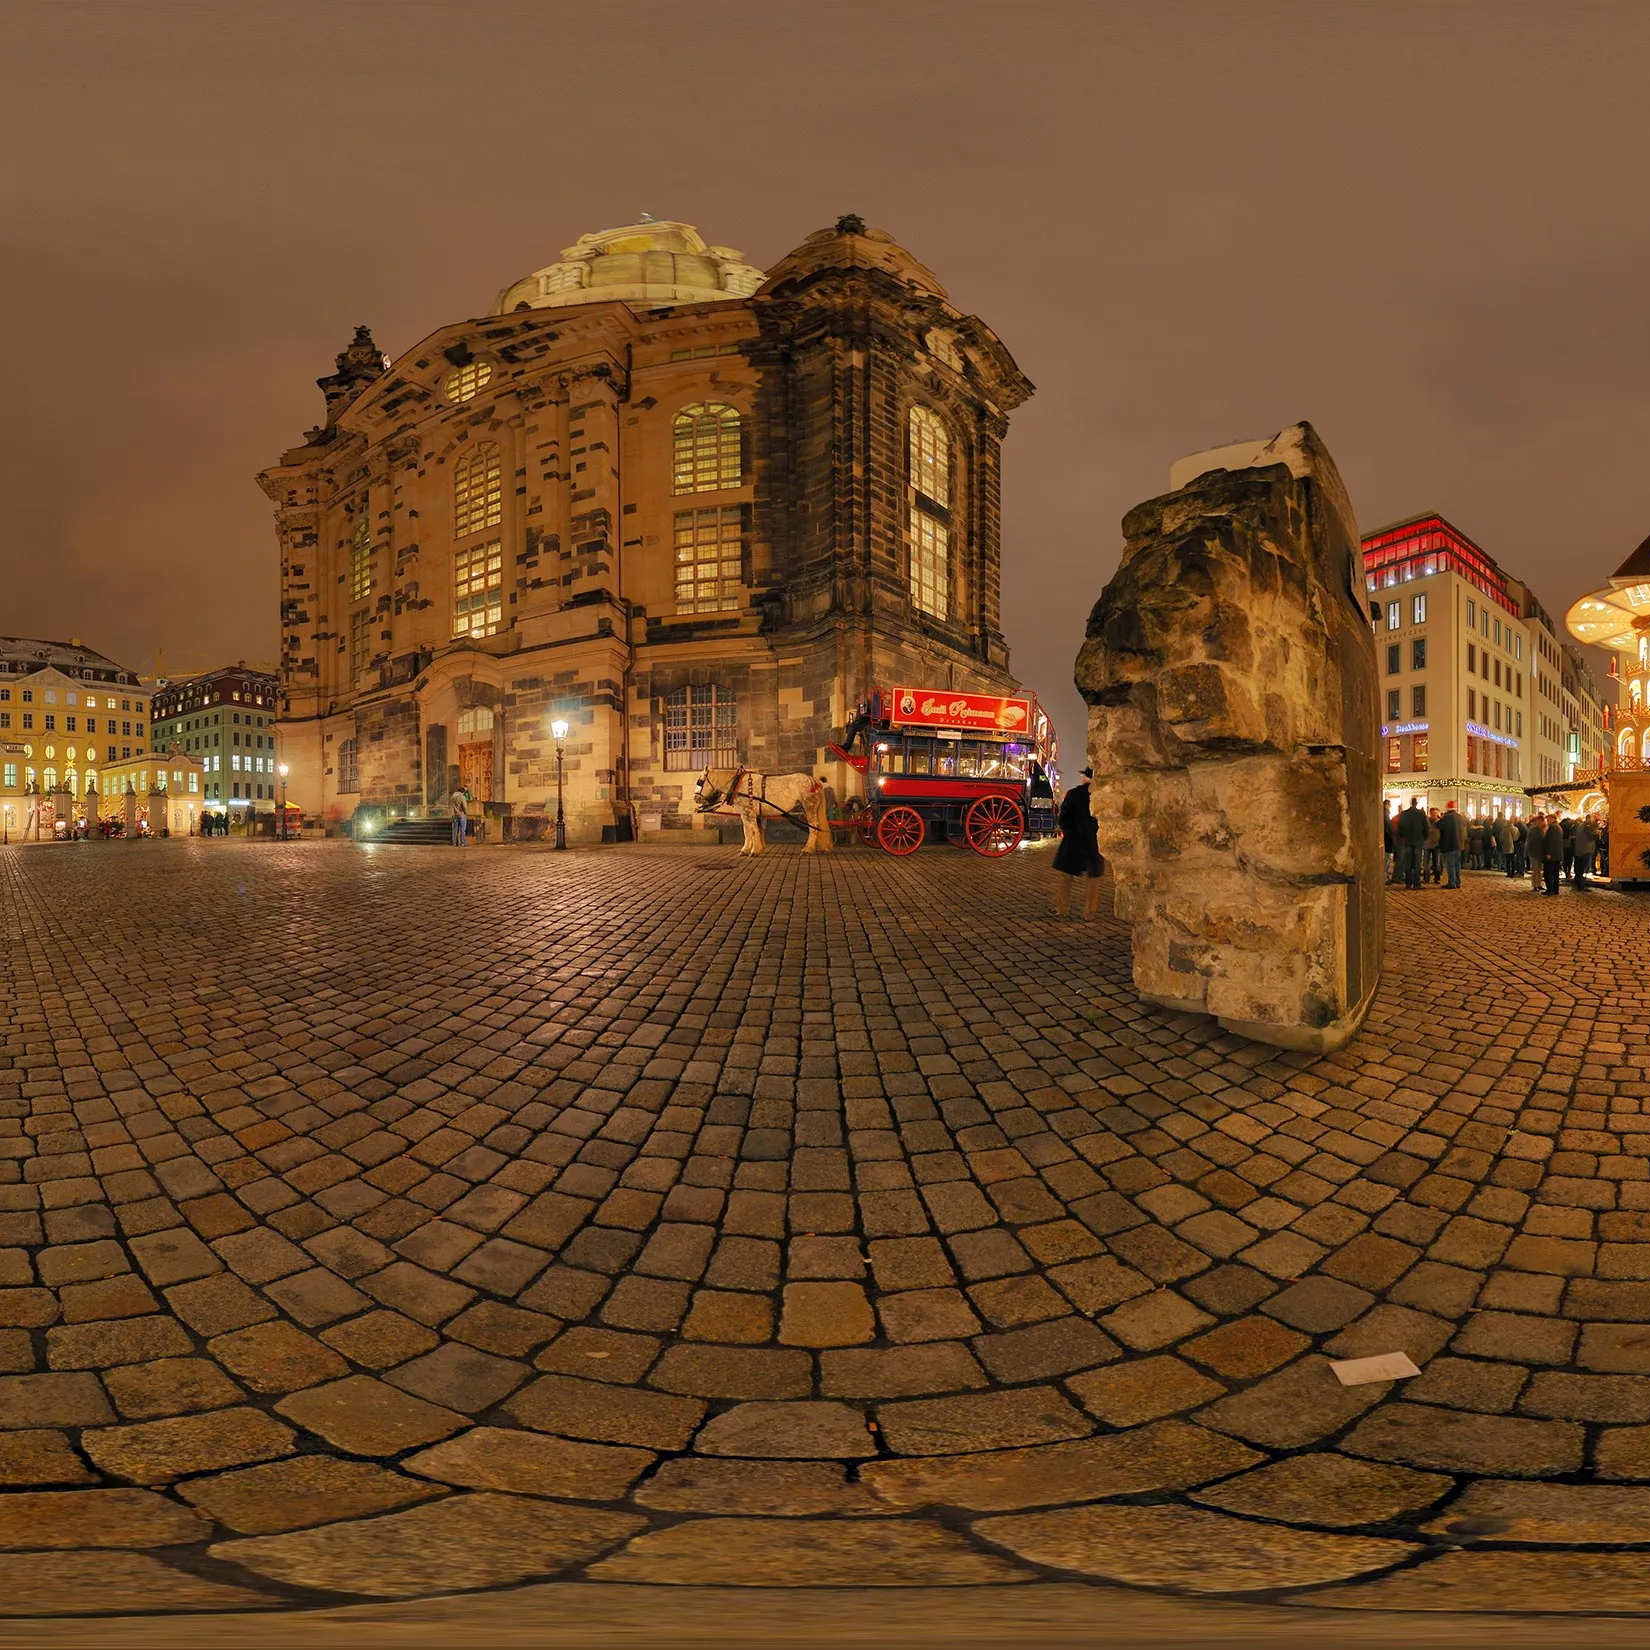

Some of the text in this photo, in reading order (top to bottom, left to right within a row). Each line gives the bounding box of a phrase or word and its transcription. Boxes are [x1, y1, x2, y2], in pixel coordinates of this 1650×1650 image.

[921, 698, 995, 718] Emil Reimann
[940, 717, 977, 725] Dresden
